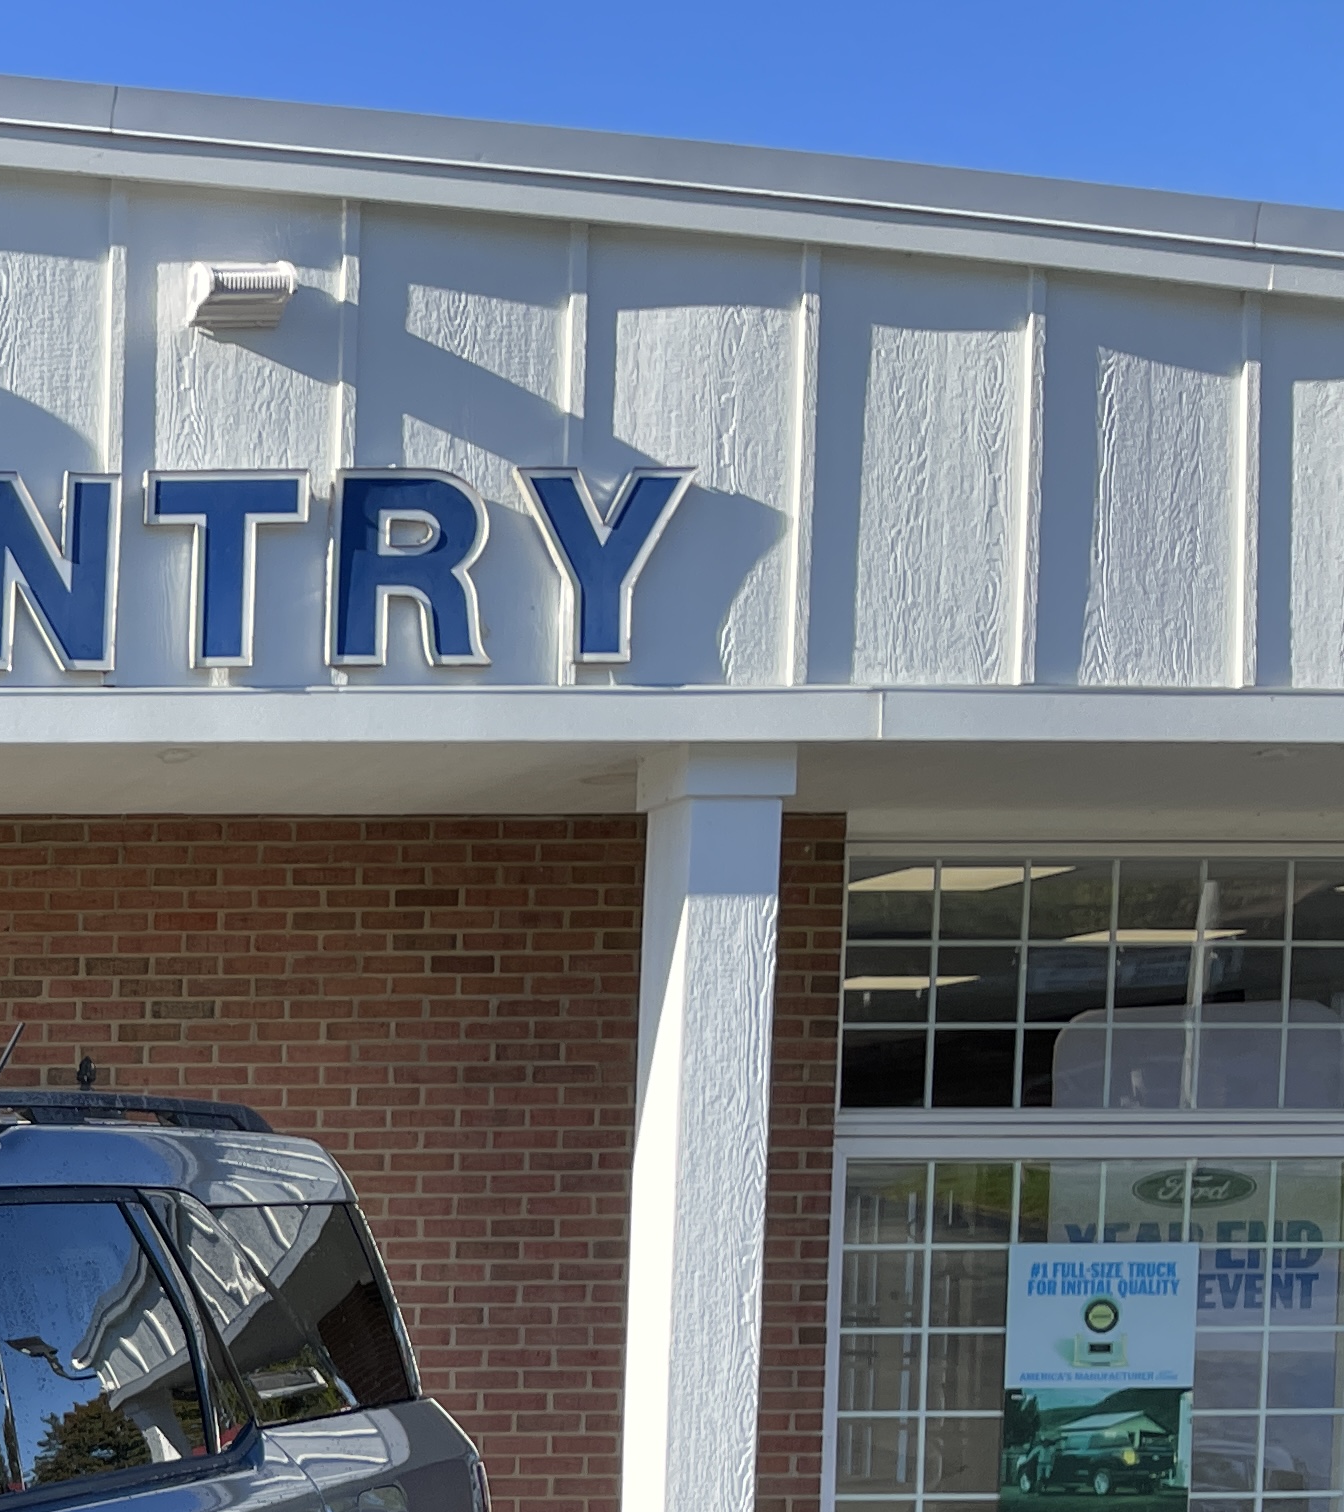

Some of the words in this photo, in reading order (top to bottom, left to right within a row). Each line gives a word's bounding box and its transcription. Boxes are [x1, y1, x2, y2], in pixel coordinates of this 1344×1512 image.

[1030, 1261, 1049, 1278] #1
[1052, 1261, 1124, 1278] FULL-SIZE
[1127, 1261, 1177, 1278] TRUCK
[1027, 1279, 1057, 1296] FOR
[1062, 1279, 1113, 1296] INITIAL
[1117, 1279, 1180, 1298] QUALITY
[1197, 1272, 1320, 1309] EVENT
[1019, 1372, 1072, 1381] AMERICA'S
[1074, 1371, 1154, 1381] MANUFACTURER
